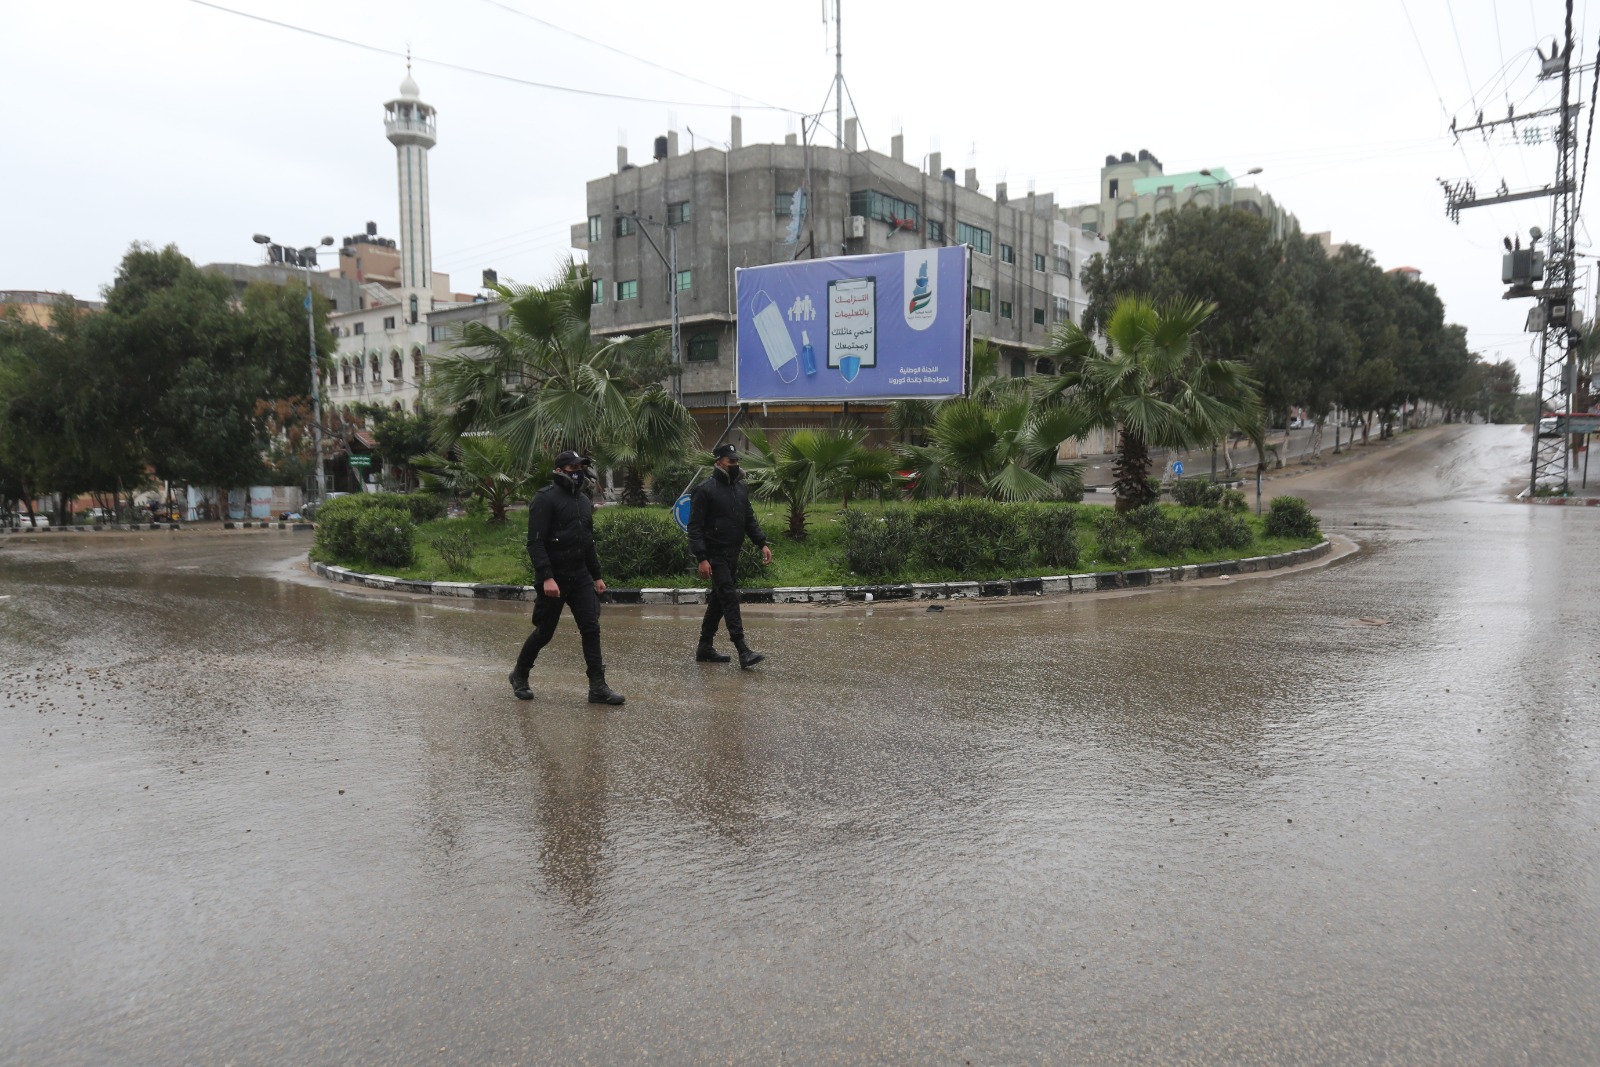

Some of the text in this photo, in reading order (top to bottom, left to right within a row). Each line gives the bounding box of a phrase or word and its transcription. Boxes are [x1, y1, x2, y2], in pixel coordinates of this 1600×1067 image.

[834, 308, 869, 319] بالتعليمات
[831, 326, 872, 339] تحمي عائلتك
[834, 341, 869, 351] ومجتمعك
[899, 366, 939, 374] اللجنة الوطنية
[888, 376, 949, 384] لمواجهة جائحة كورونا
